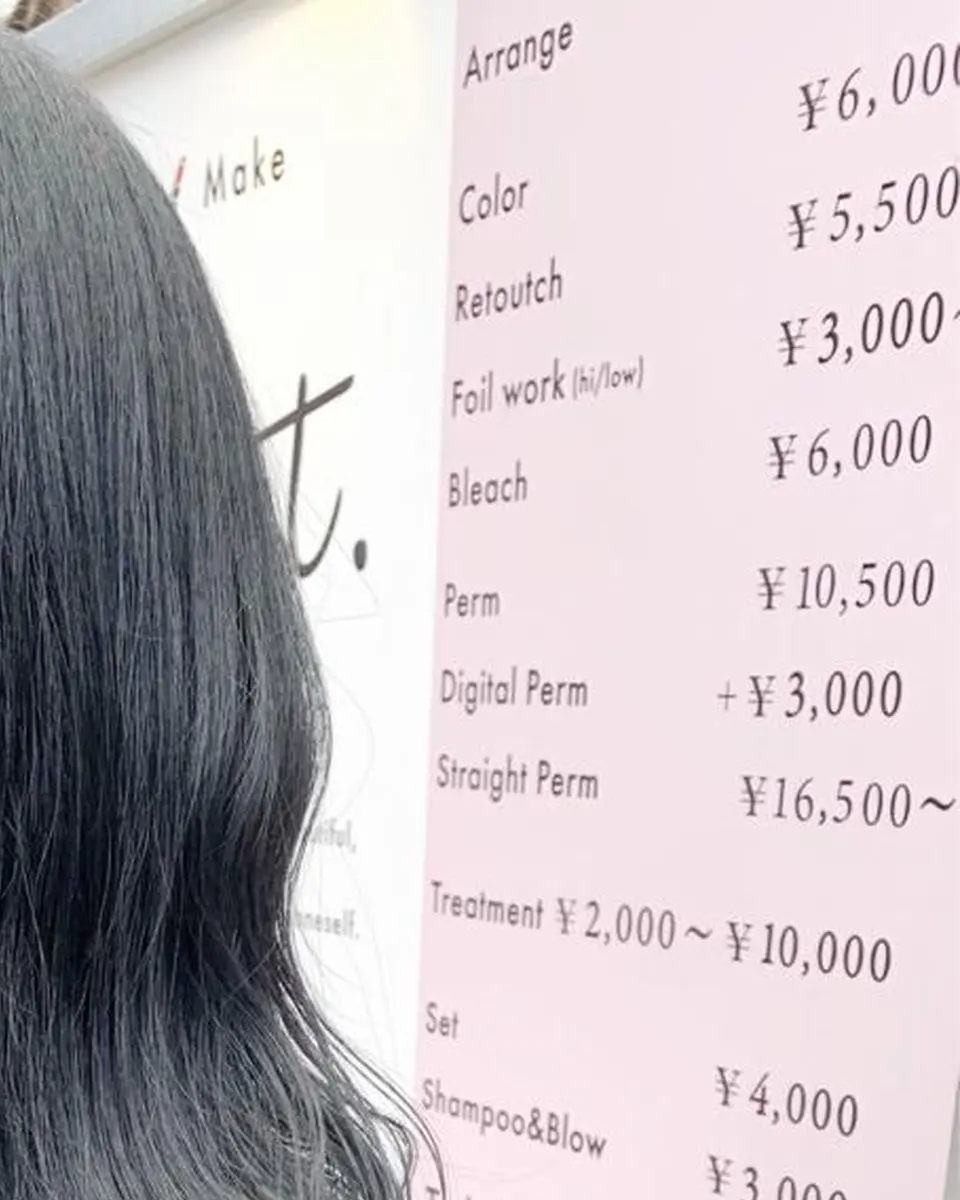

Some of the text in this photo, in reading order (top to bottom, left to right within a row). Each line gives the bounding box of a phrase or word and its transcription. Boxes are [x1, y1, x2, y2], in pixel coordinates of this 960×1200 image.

[461, 20, 574, 90] Arrange
[202, 135, 286, 208] Make
[458, 171, 530, 226] Color
[454, 164, 960, 323] Retoutch ¥5,500
[451, 290, 960, 418] Foil work (hi/low) ¥3,000
[447, 413, 933, 509] Bleach ¥6,000
[443, 558, 936, 618] Perm ¥10,500
[440, 665, 518, 716] Digital
[525, 668, 589, 708] Perm
[436, 753, 529, 804] Straight
[536, 758, 599, 800] Perm
[430, 879, 545, 930] Treatment
[425, 1001, 859, 1139] Set ¥4,000
[421, 1077, 607, 1160] Shampoo&Blow
